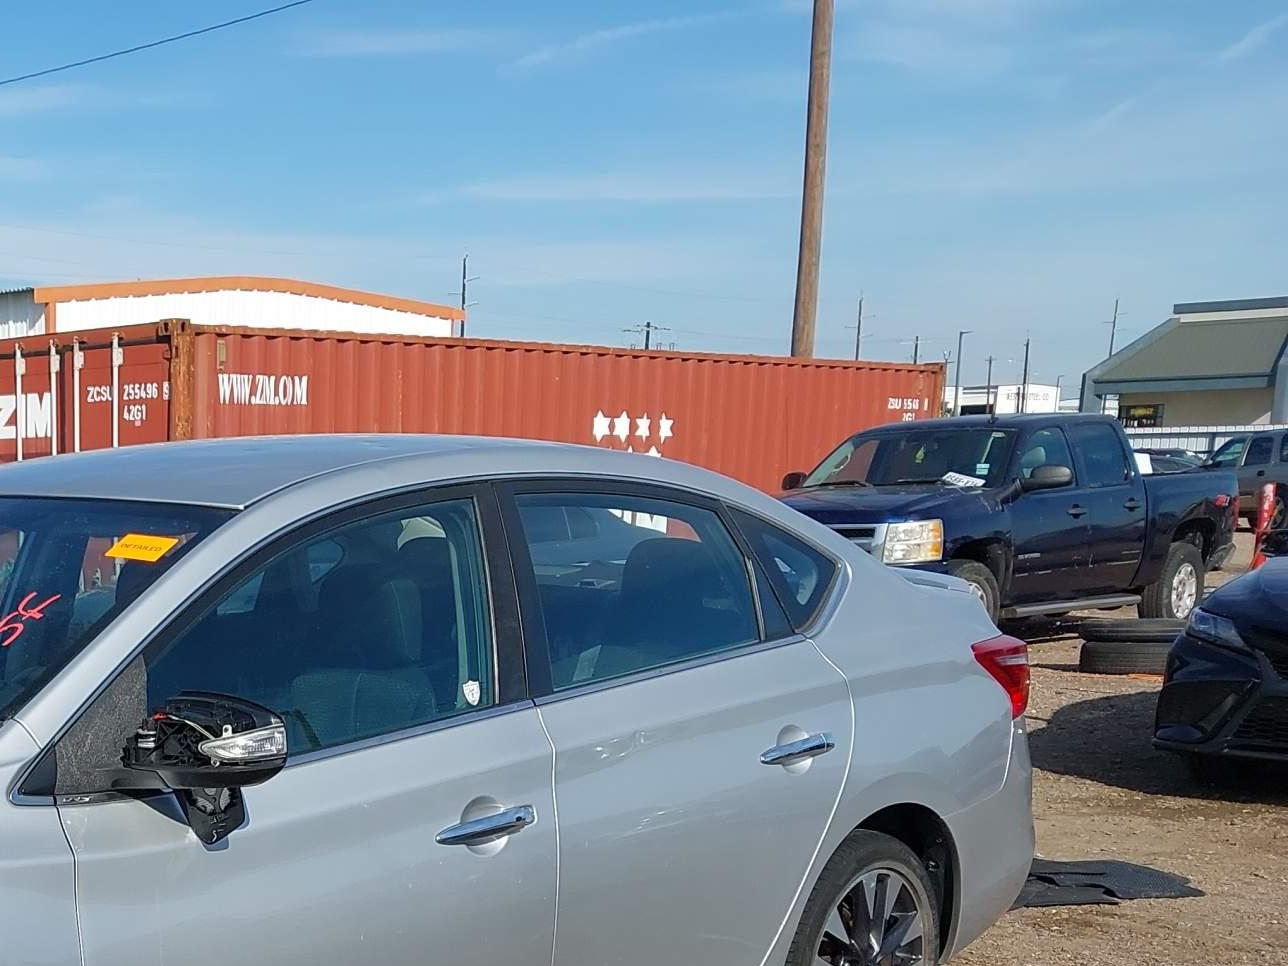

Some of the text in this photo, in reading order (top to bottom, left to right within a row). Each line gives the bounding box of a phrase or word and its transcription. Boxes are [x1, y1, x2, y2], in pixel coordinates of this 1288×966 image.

[123, 382, 159, 400] 255496
[123, 404, 146, 421] 42G1
[119, 543, 163, 553] DETAILED
